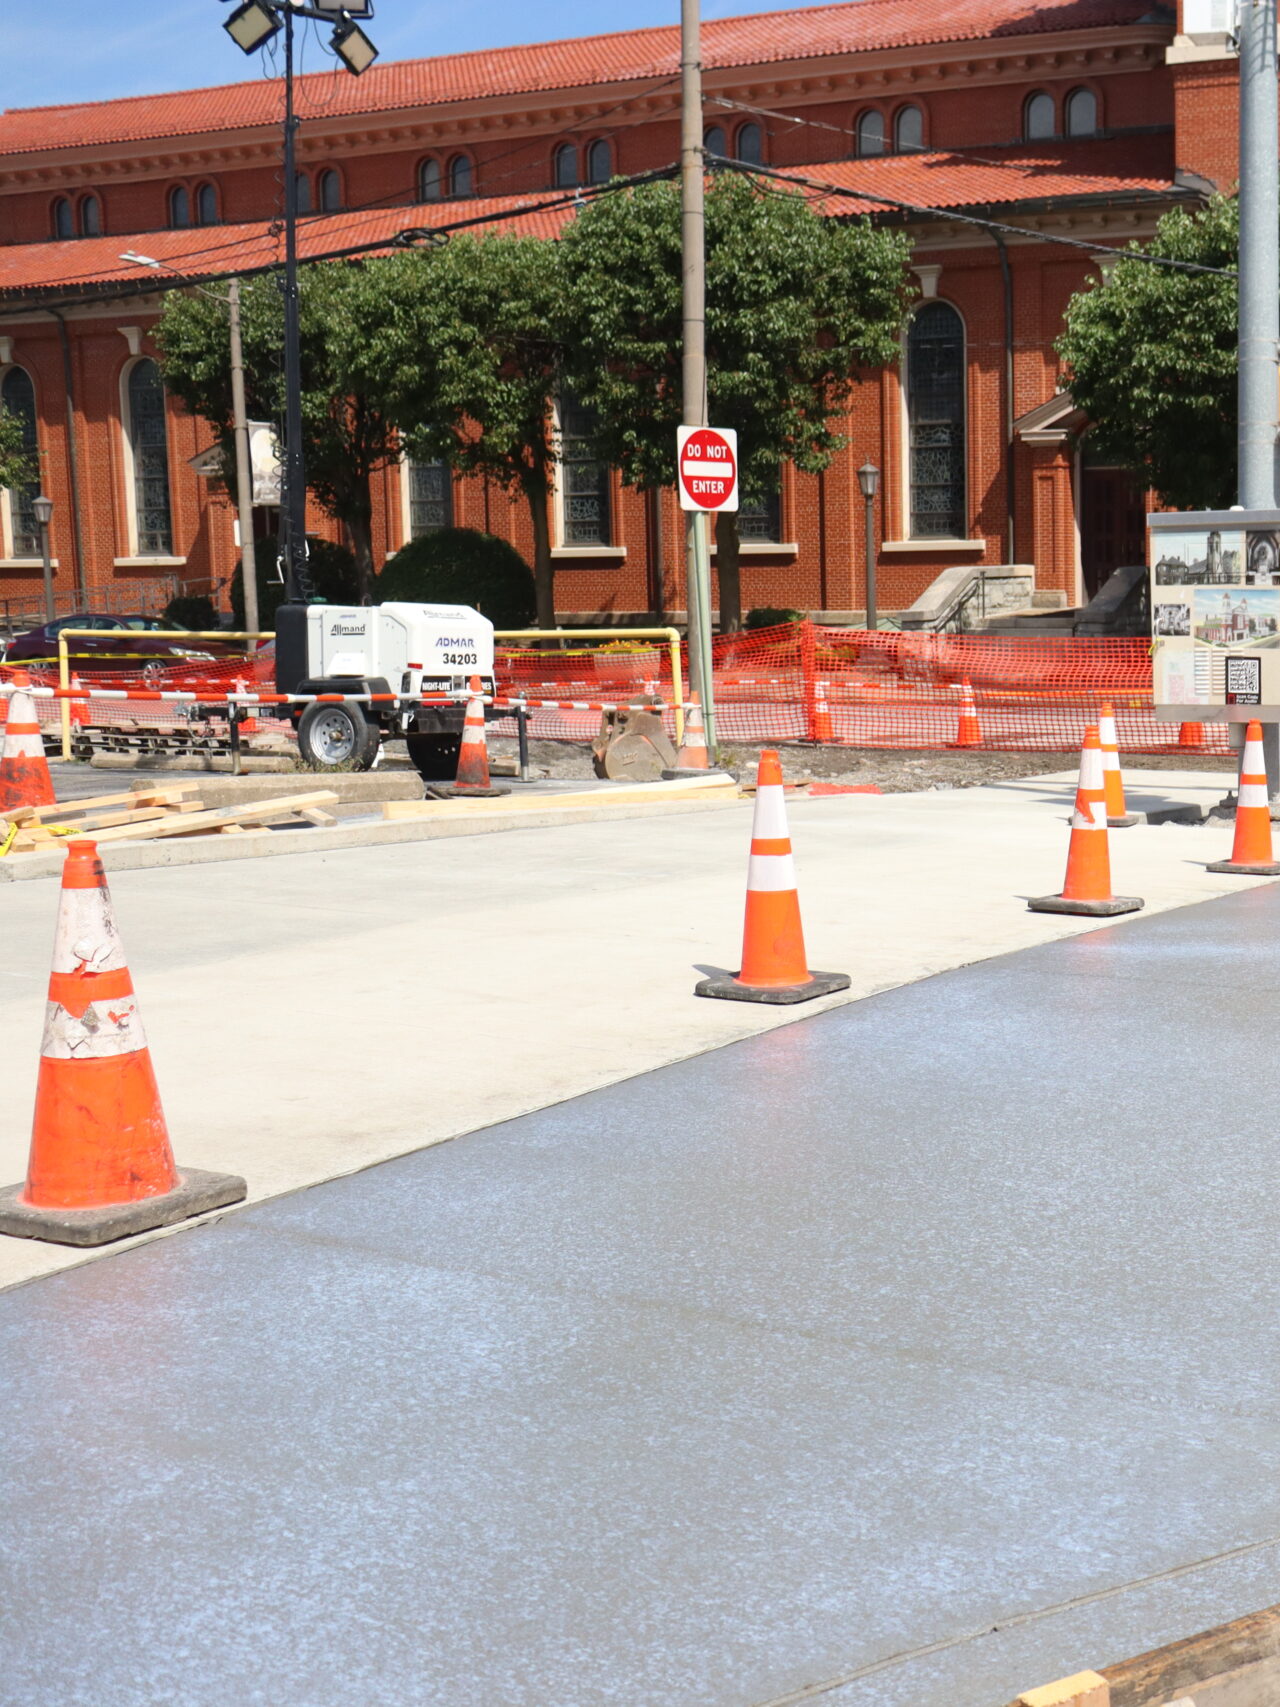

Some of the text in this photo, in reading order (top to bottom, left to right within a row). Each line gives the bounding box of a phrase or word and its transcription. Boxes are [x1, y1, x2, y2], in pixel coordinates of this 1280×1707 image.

[687, 445, 727, 458] DO NOT
[692, 481, 724, 494] ENTER
[330, 624, 366, 636] Allmand
[435, 637, 474, 648] ADMAR
[443, 653, 477, 665] 34203
[422, 682, 451, 691] NIGHT-LITE
